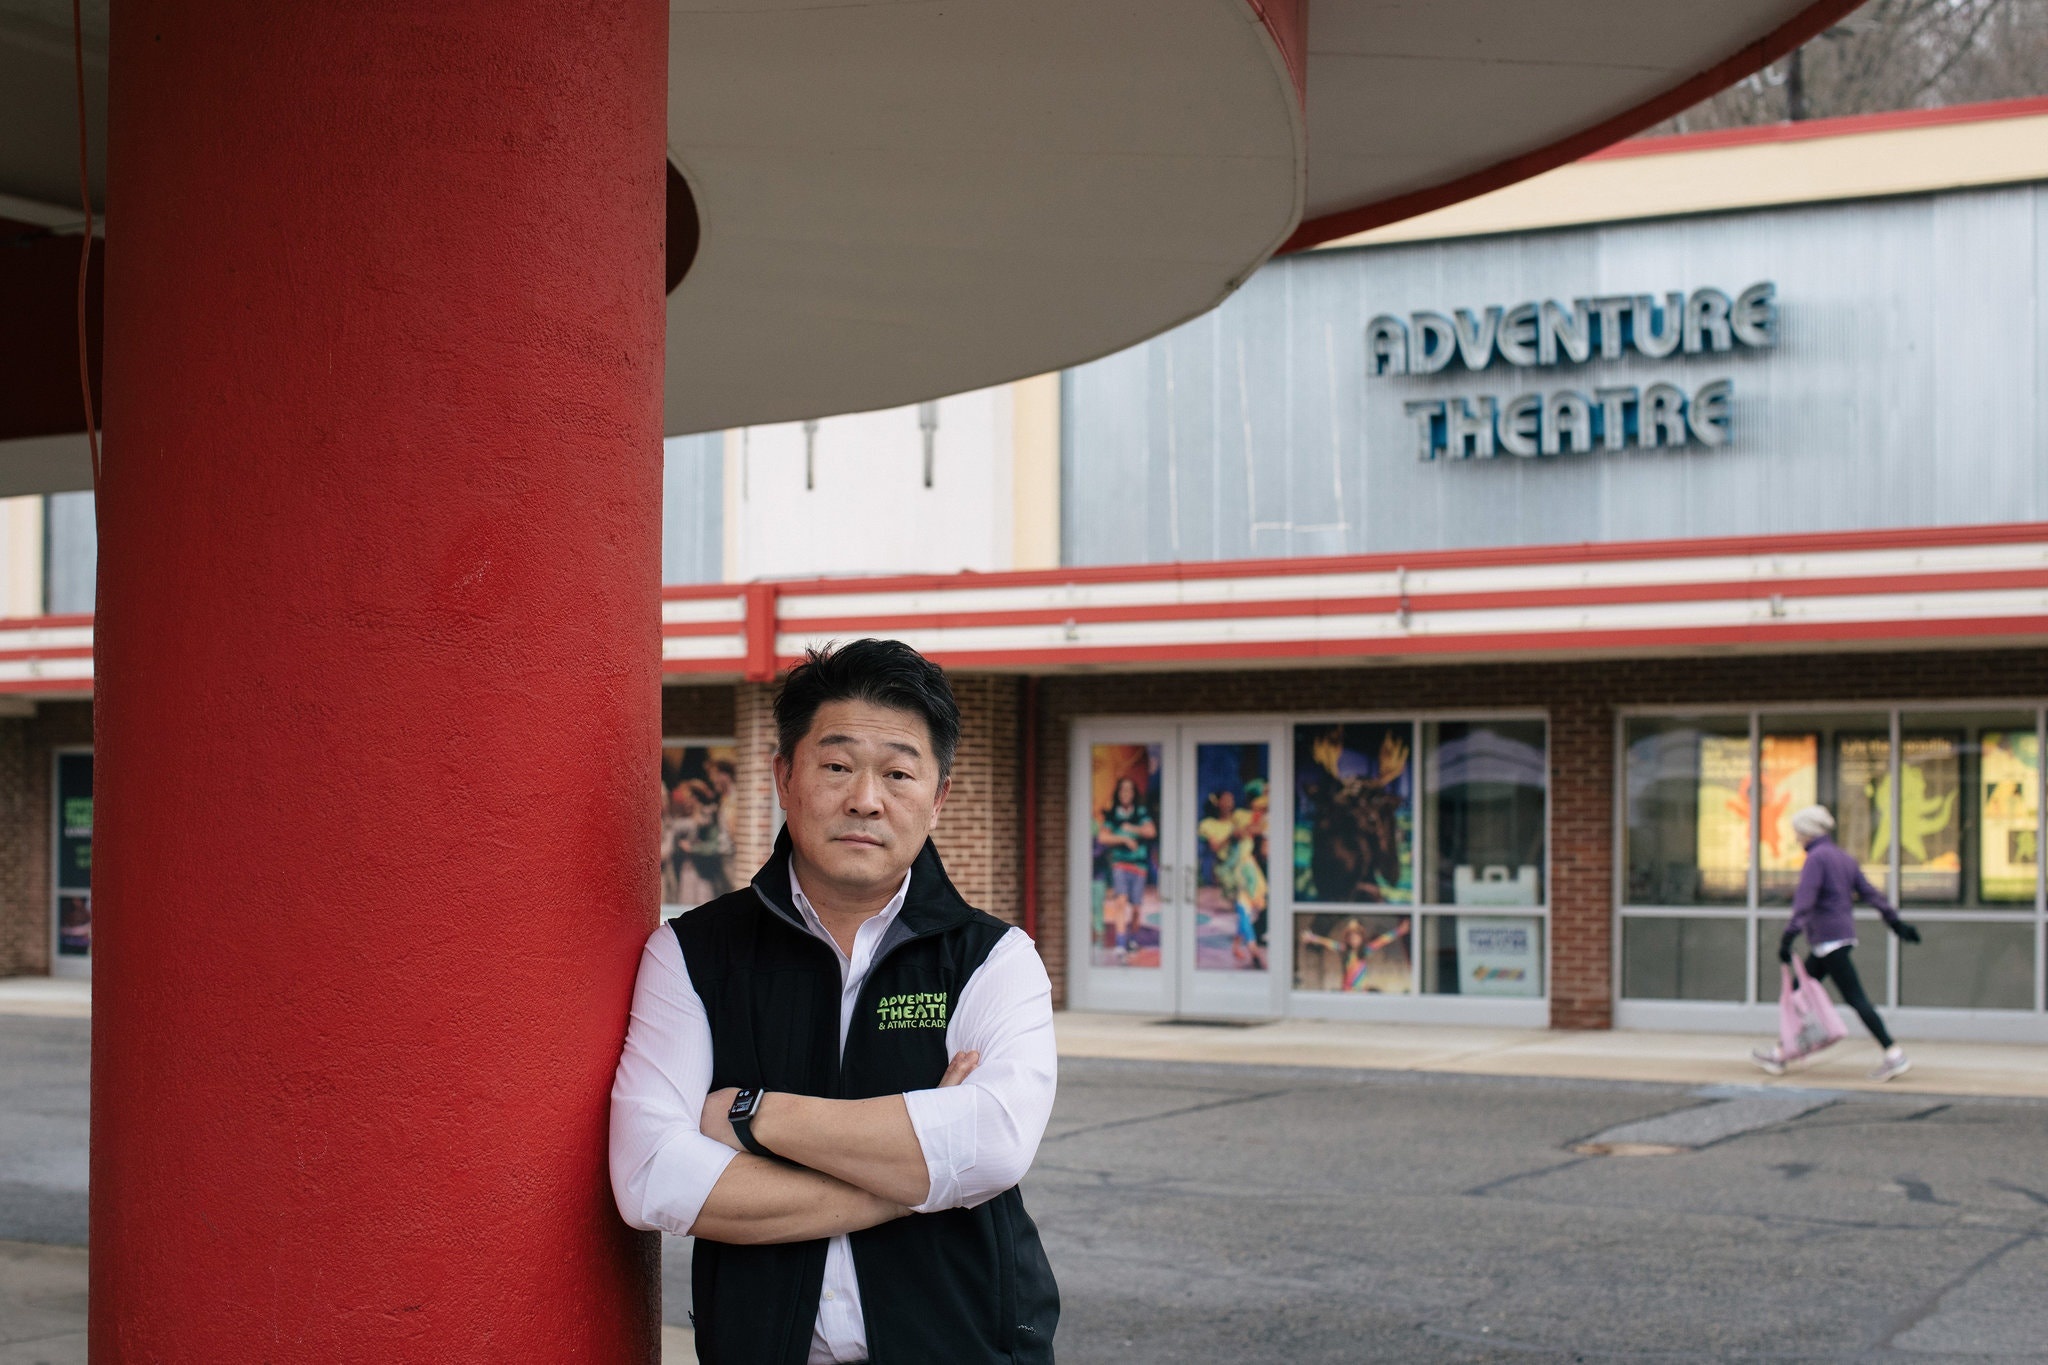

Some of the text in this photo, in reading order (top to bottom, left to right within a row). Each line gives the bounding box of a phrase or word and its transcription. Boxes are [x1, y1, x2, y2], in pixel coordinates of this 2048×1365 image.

[1365, 281, 1776, 377] ADVENTURE
[1403, 378, 1734, 462] THEATRE
[878, 1021, 886, 1031] &
[887, 1020, 917, 1030] ATMTC
